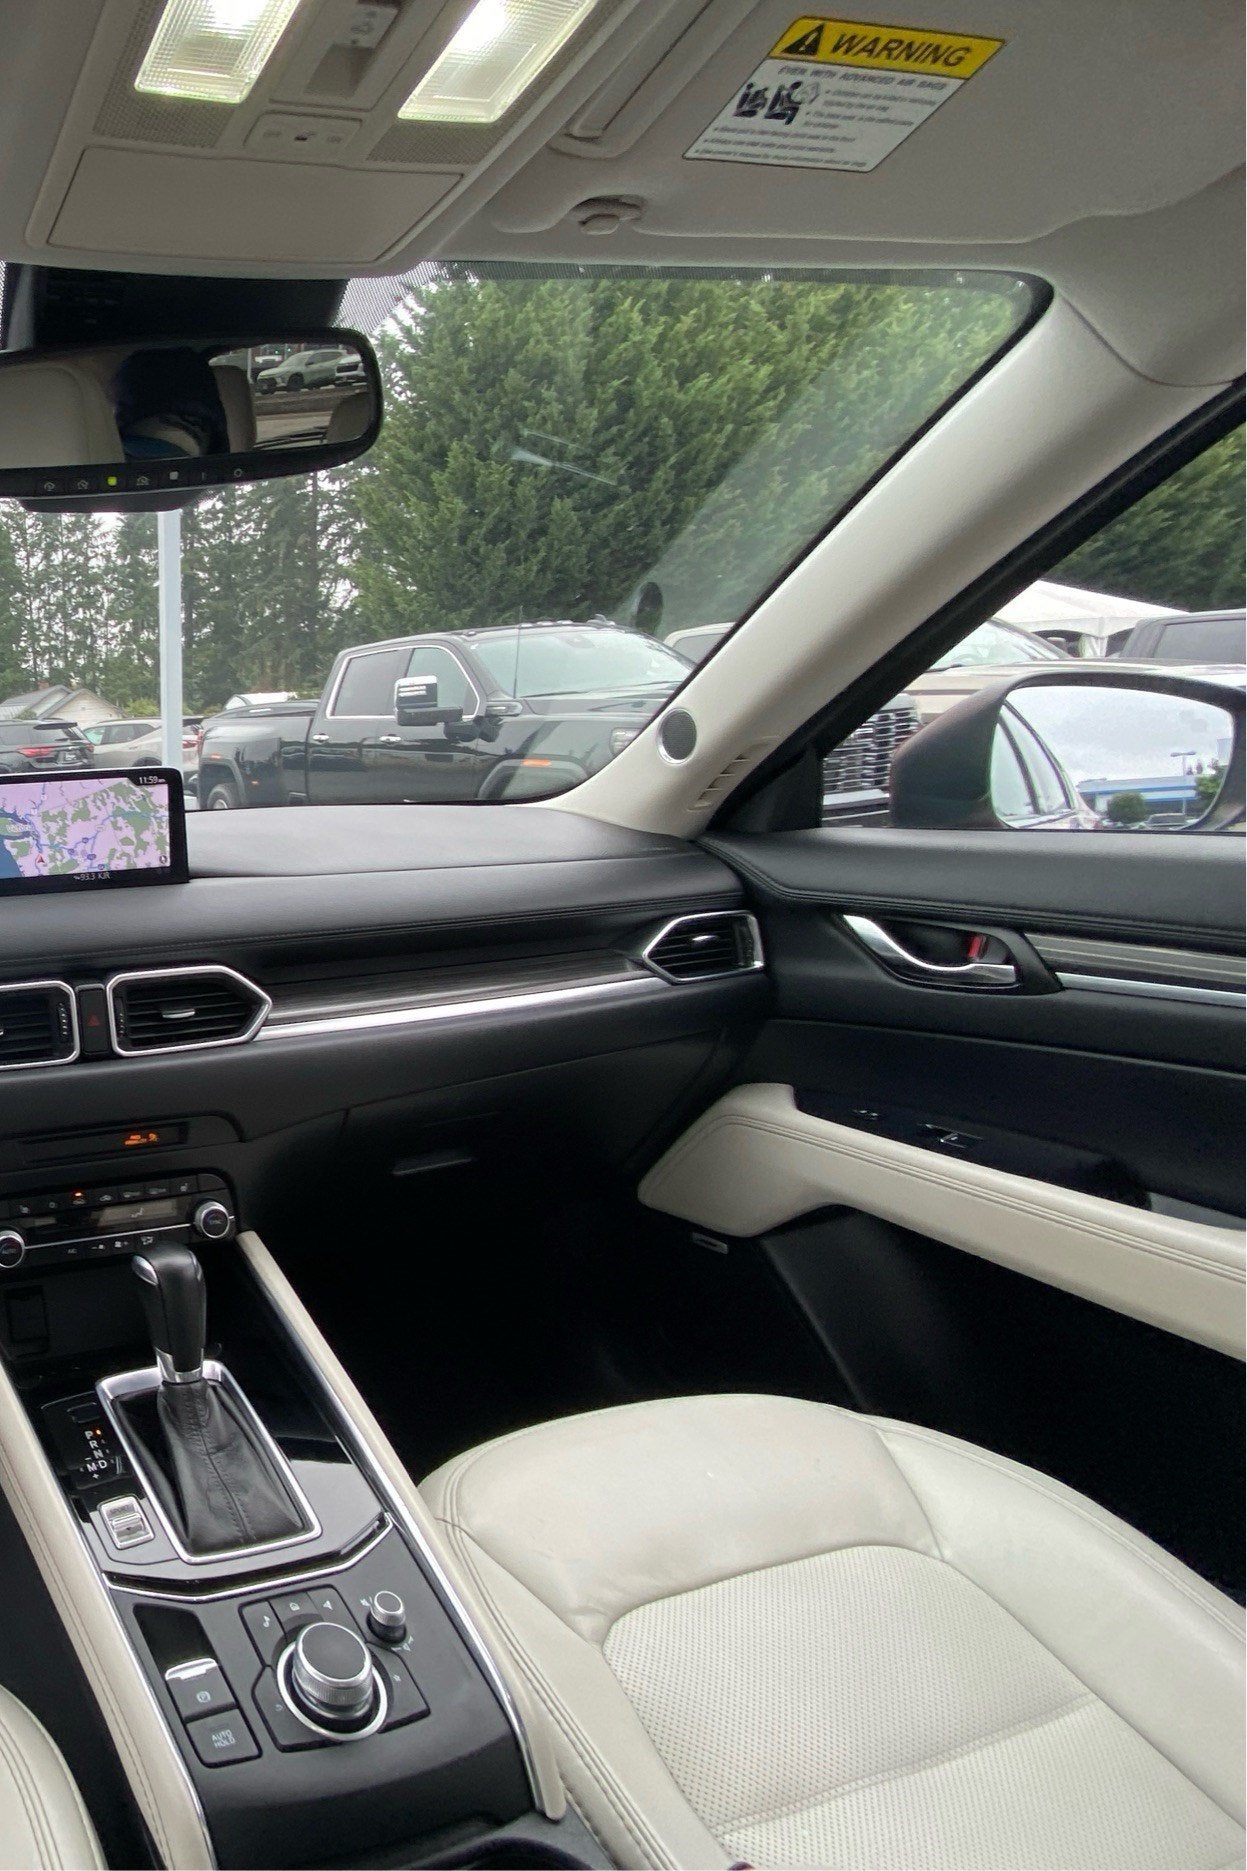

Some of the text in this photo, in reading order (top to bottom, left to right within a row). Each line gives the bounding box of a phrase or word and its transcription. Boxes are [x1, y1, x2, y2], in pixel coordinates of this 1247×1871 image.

[831, 33, 973, 67] WARNING
[84, 1430, 94, 1440] P
[89, 1440, 99, 1449] R
[93, 1449, 104, 1459] N
[86, 1460, 108, 1472] M D
[212, 1729, 232, 1741] AUTO
[214, 1737, 235, 1748] HOLD
